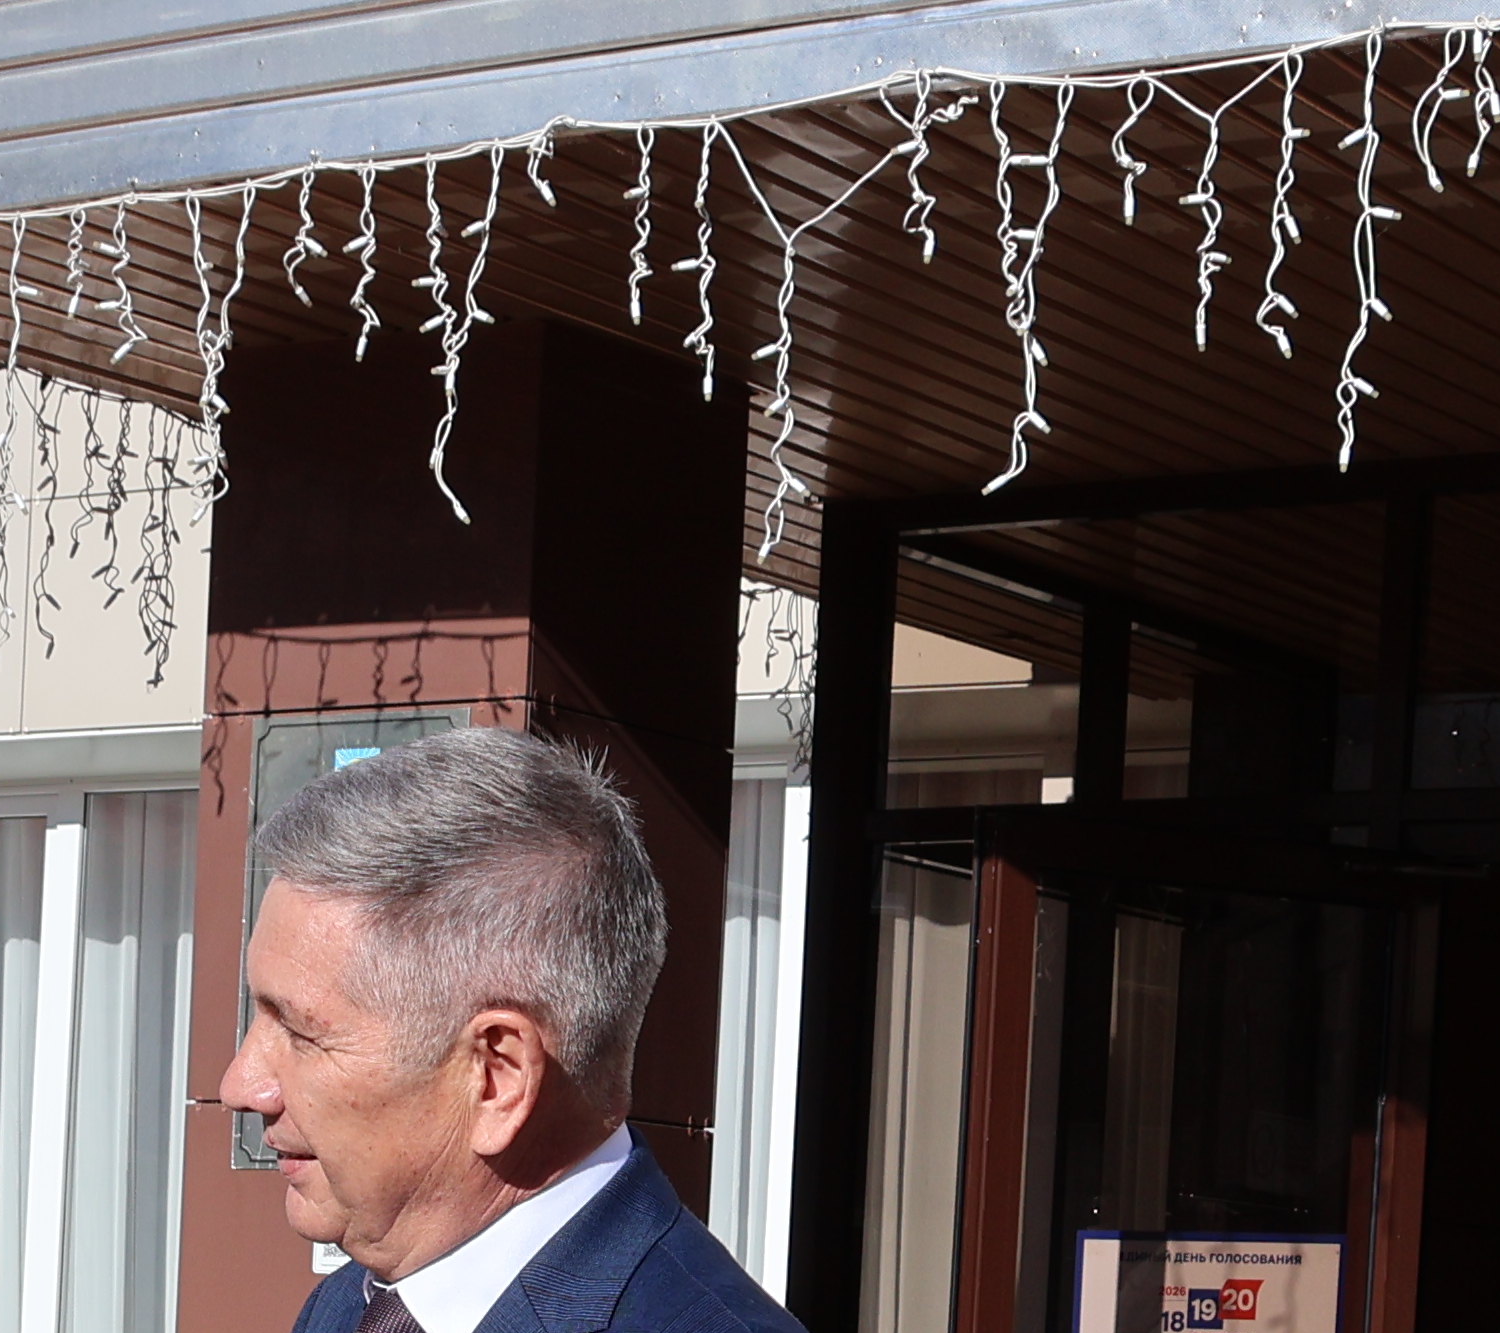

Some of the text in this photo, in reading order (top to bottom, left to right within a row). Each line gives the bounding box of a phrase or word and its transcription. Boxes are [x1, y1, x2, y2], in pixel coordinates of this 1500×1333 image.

[1174, 1252, 1206, 1264] ДЕНЬ
[1209, 1253, 1302, 1266] ГОЛОСОВАНИЯ
[1158, 1286, 1187, 1297] 2026
[1222, 1288, 1254, 1311] 20
[1190, 1298, 1217, 1320] 19
[1160, 1310, 1185, 1332] 18
